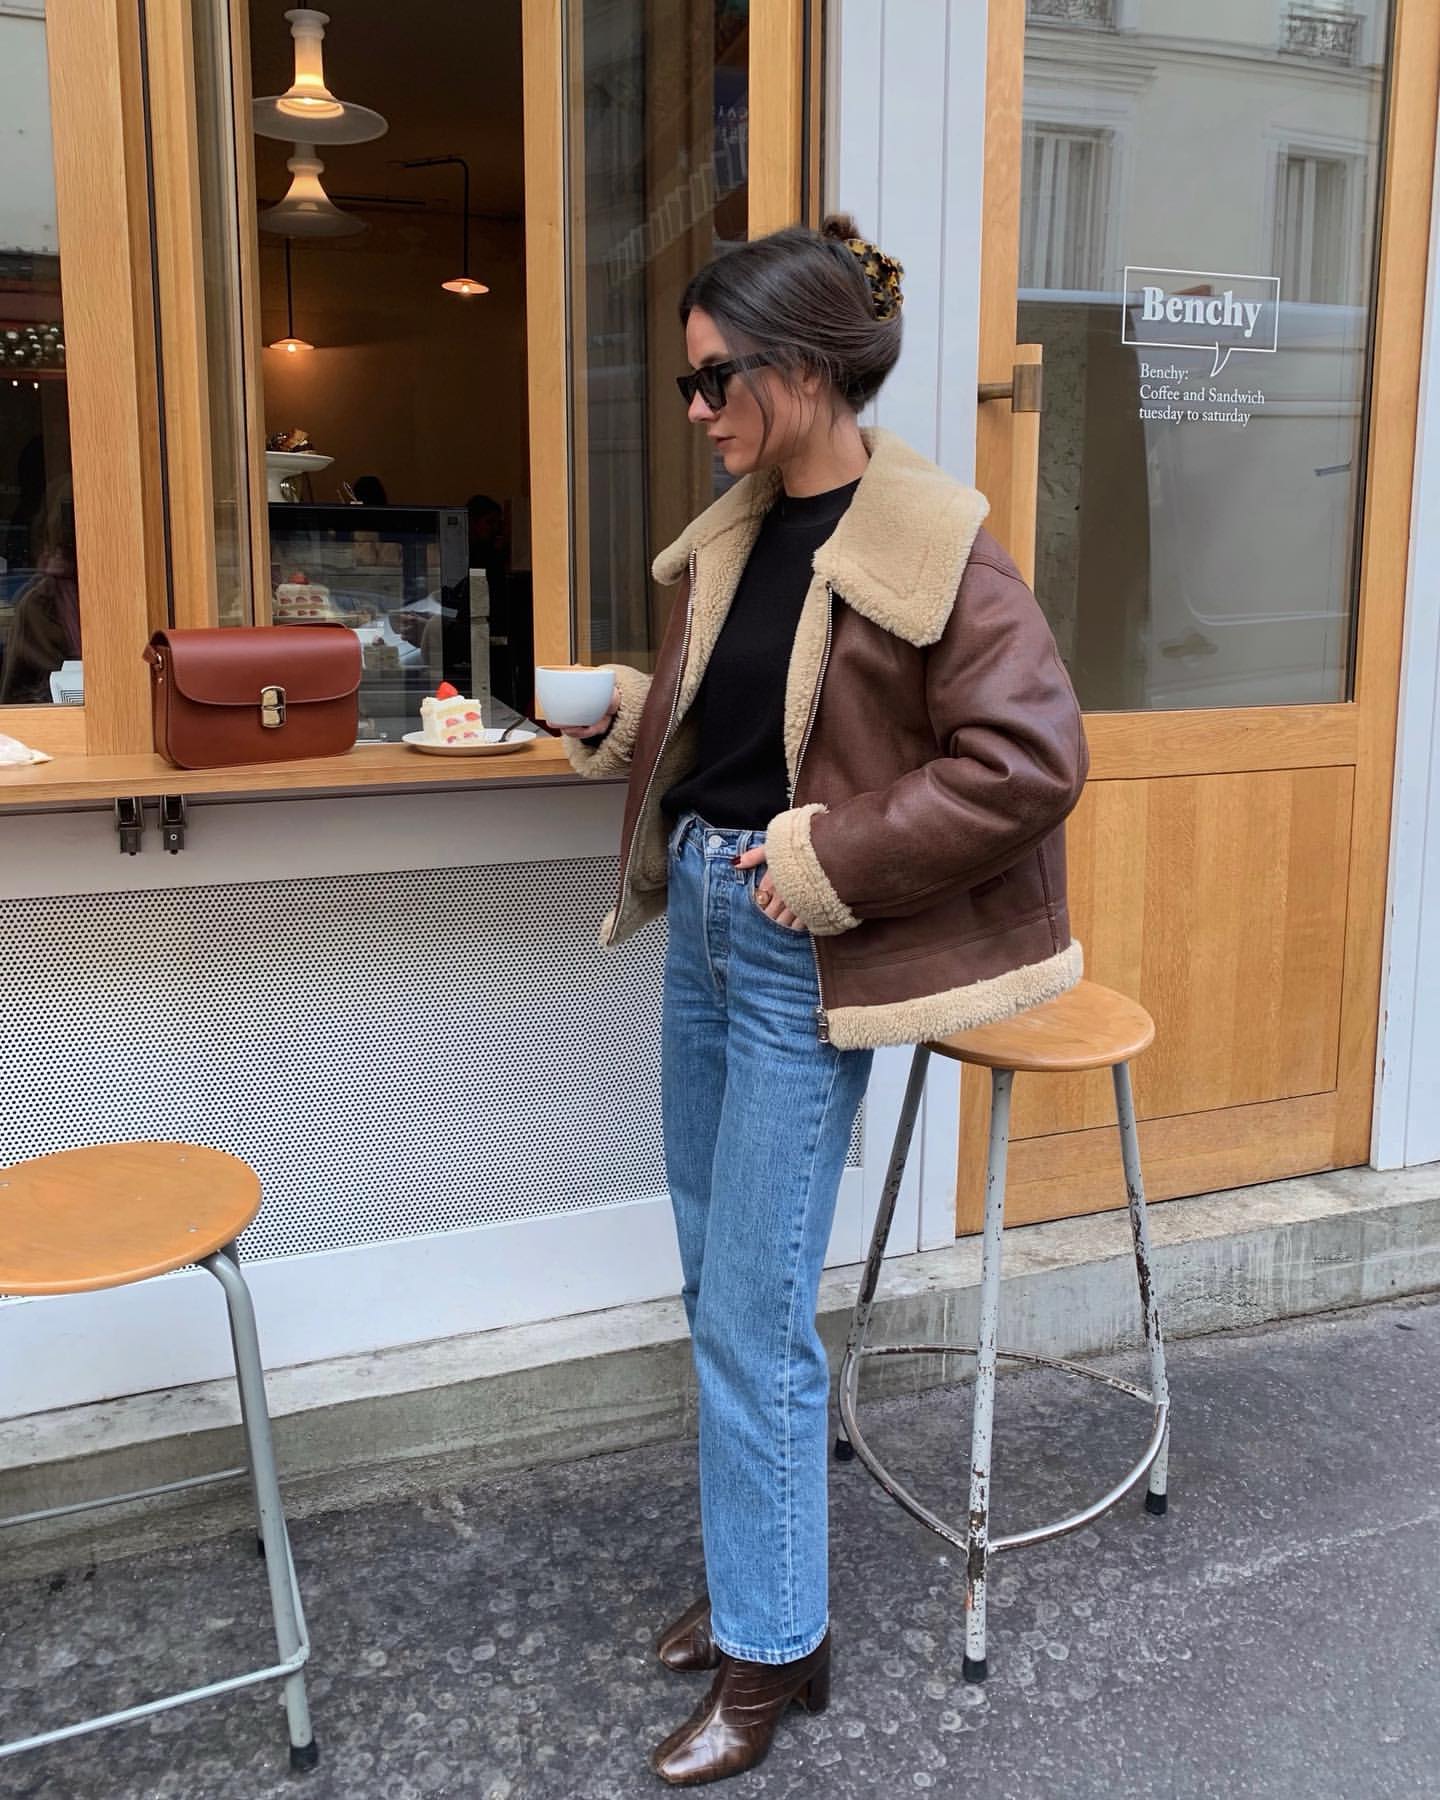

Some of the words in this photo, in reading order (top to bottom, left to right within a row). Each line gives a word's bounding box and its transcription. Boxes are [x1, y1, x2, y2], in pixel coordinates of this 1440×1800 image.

[1142, 286, 1262, 338] Benchy
[1140, 362, 1189, 384] Benchy:
[1139, 384, 1180, 400] Coffee
[1183, 388, 1205, 401] and
[1208, 387, 1265, 404] Sandwich
[1139, 406, 1184, 424] tuesday
[1187, 410, 1199, 421] to
[1202, 408, 1251, 427] saturday
